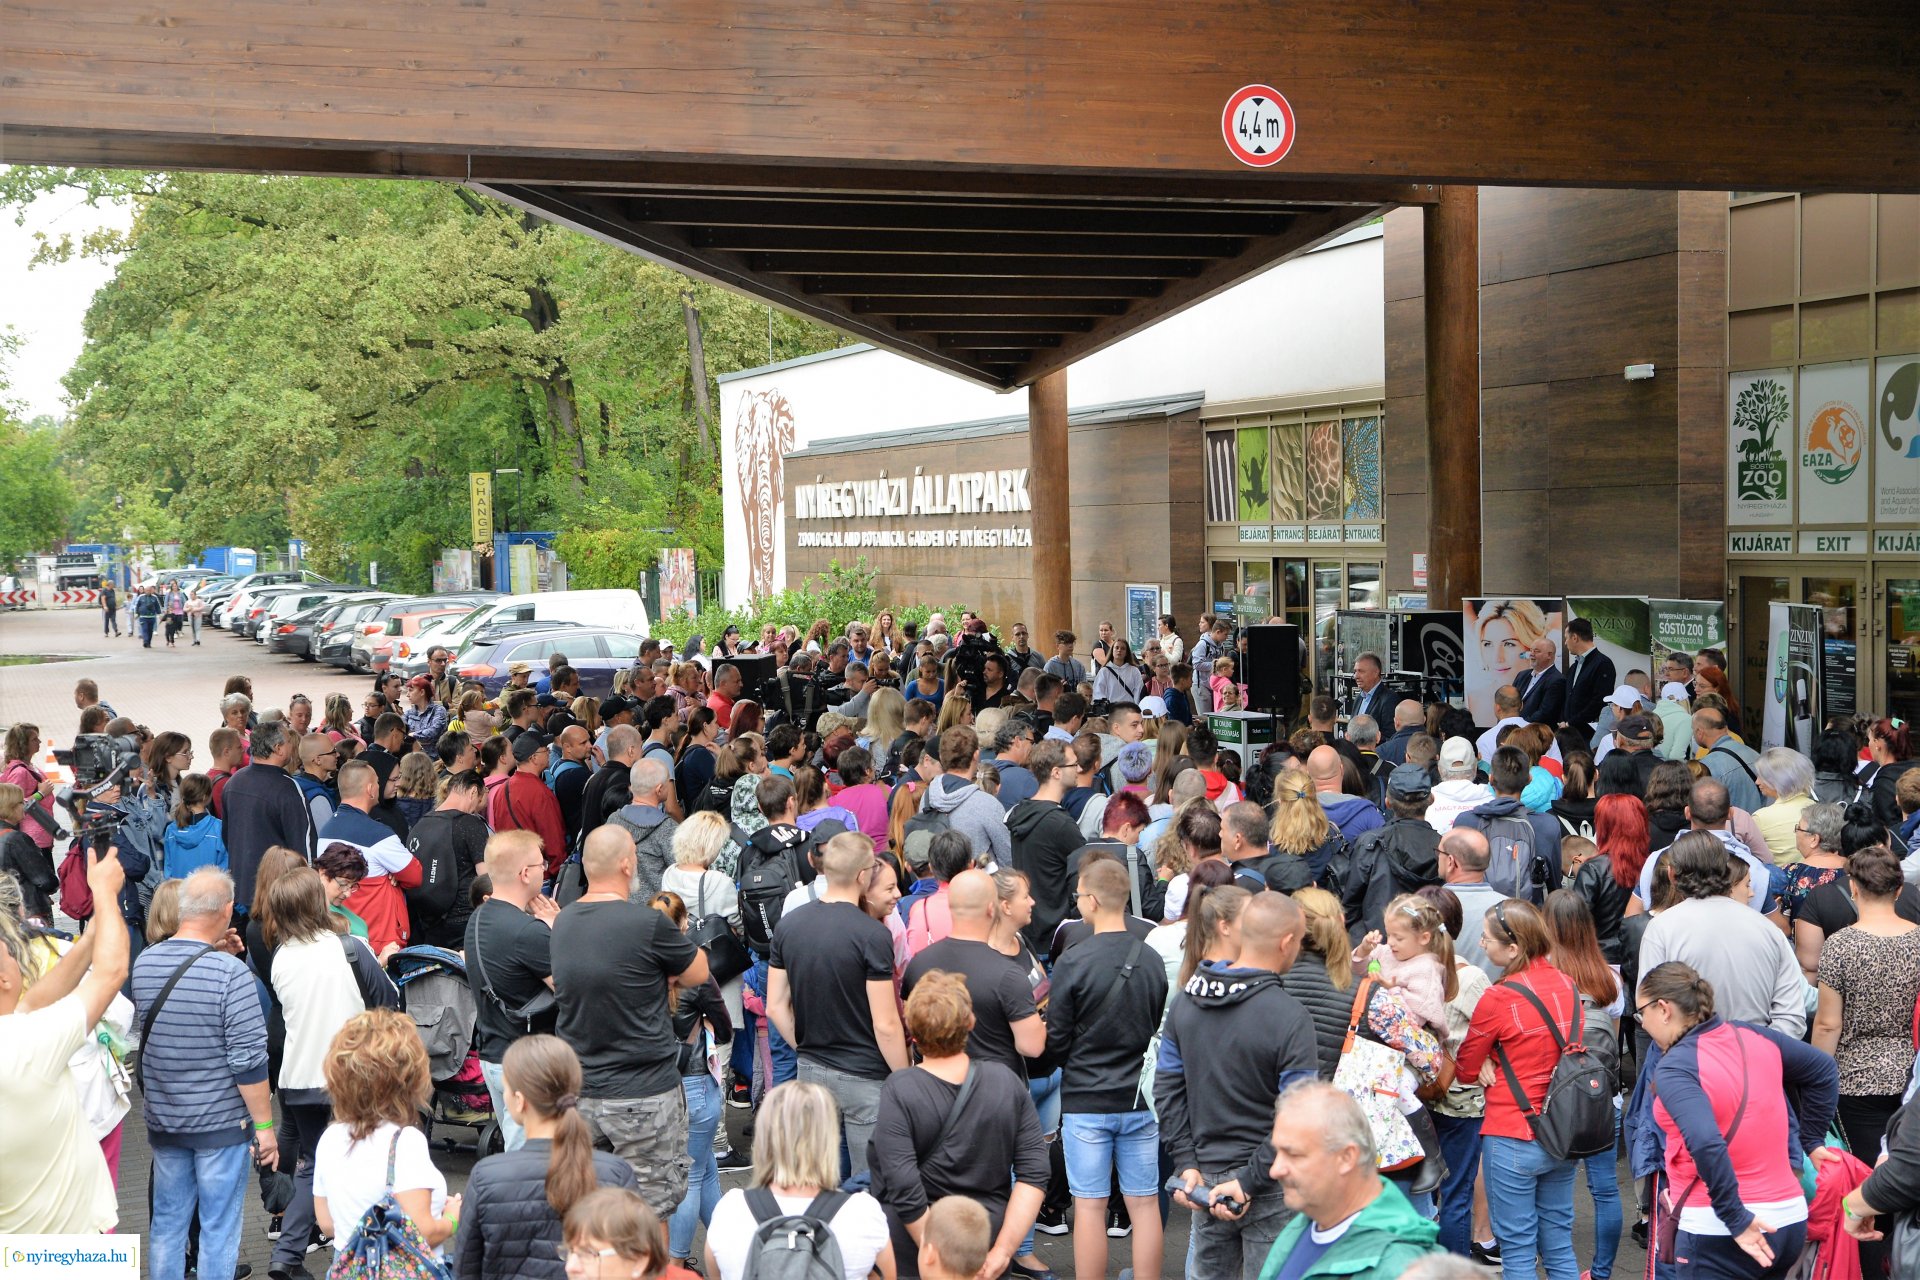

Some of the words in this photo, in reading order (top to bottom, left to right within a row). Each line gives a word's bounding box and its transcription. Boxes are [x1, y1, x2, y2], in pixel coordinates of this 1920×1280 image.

[1803, 453, 1832, 467] EAZA
[1742, 470, 1782, 487] ZOO
[795, 469, 908, 519] NYÍREGYHÁZI
[911, 465, 1031, 515] ÁLLATPARK
[475, 477, 487, 537] CHANGE
[798, 531, 843, 546] ZOOLOGICAL
[844, 531, 860, 546] AND
[861, 530, 906, 546] BOTANICAL
[908, 529, 945, 546] GARDEN
[946, 529, 959, 546] OF
[1240, 528, 1269, 540] BEJÁRAT
[1273, 530, 1304, 540] ENTRANCE
[1308, 527, 1340, 540] BEJÁRAT
[1344, 529, 1380, 540] ENTRANCE
[1732, 534, 1791, 551] KIJÁRAT
[1816, 537, 1851, 551] EXIT
[1659, 619, 1686, 635] SÓSTÓ
[1687, 623, 1703, 636] ZOO
